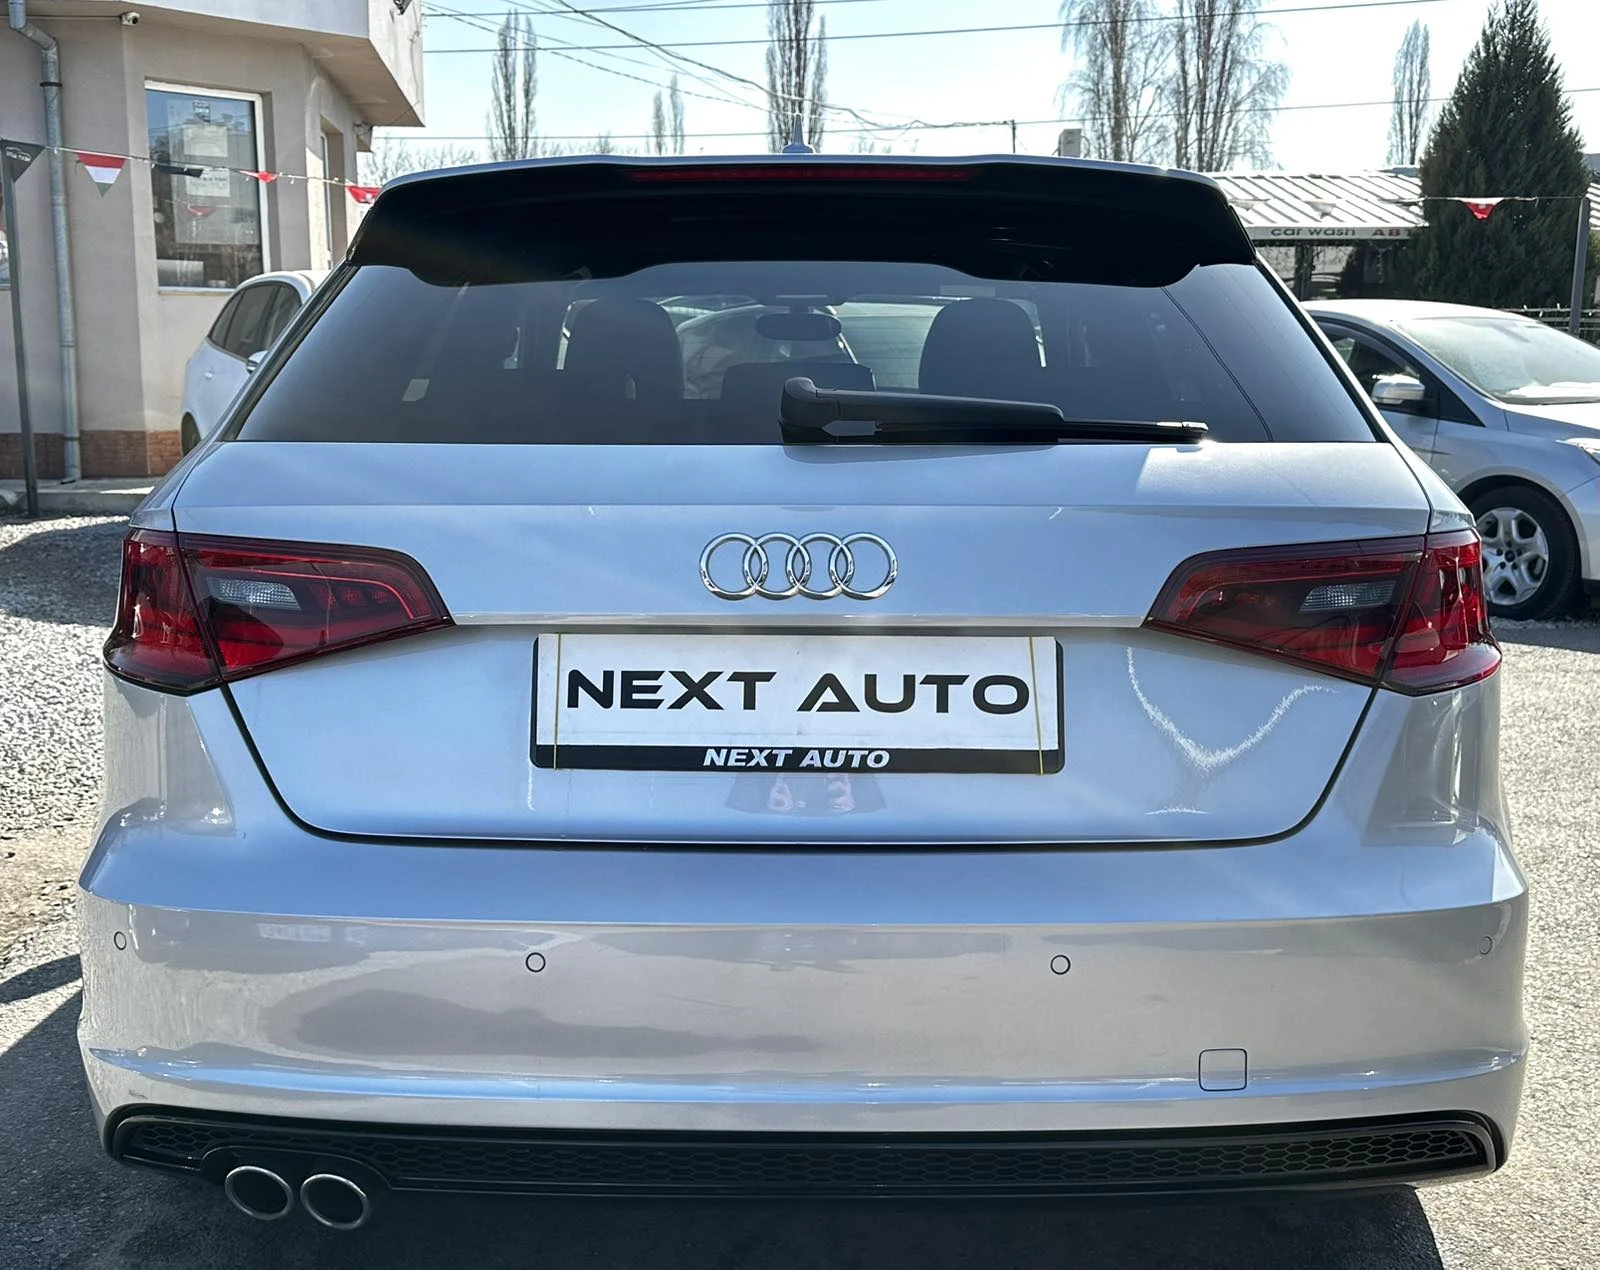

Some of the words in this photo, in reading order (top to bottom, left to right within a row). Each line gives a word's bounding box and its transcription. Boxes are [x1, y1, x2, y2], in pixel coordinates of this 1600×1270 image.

[1270, 228, 1302, 237] car
[1308, 227, 1356, 237] wash
[567, 669, 777, 711] NEXT
[796, 672, 1030, 714] AUTO
[703, 748, 793, 767] NEXT
[799, 749, 890, 769] AUTO
